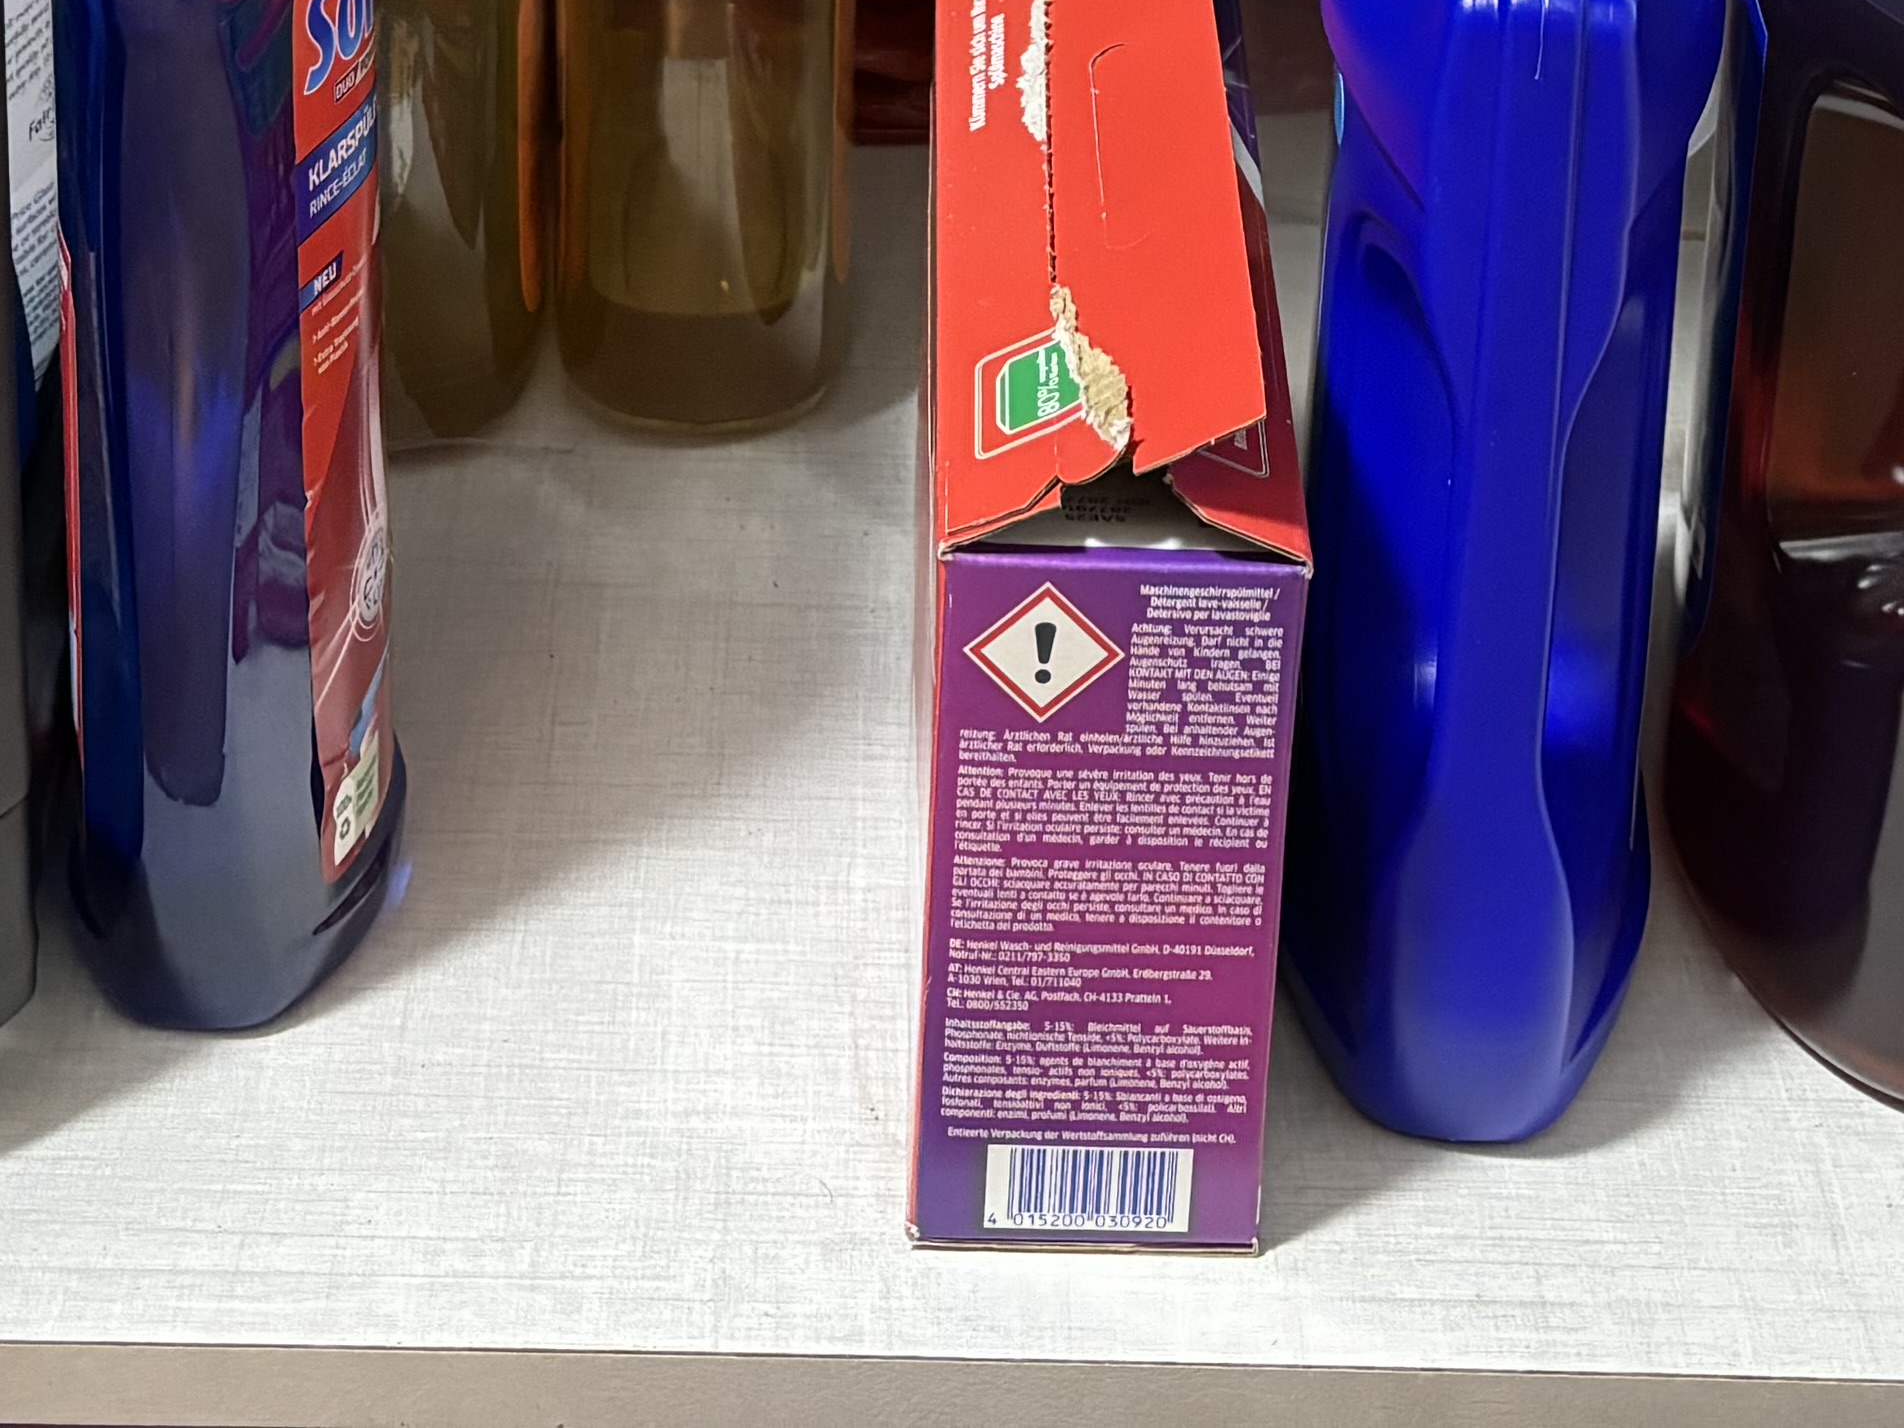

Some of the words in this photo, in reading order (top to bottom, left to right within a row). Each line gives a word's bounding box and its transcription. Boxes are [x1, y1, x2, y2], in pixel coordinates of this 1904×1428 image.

[336, 72, 356, 100] DUO
[313, 261, 337, 297] NEU
[1037, 376, 1060, 417] 80%
[1139, 584, 1274, 600] Maschinengeschirrspülmittel
[1146, 608, 1192, 620] Detersivo
[1193, 610, 1211, 621] per
[1184, 624, 1234, 636] Verursacht
[1201, 635, 1222, 646] Darf
[1226, 637, 1249, 647] nicht
[1268, 638, 1284, 648] die
[1128, 667, 1174, 679] KONTAKT
[1174, 668, 1192, 679] MIT
[1193, 669, 1213, 680] DEN
[966, 939, 998, 951] Henkel
[1034, 941, 1052, 952] und
[1053, 941, 1130, 955] Reinigungsmittel
[964, 963, 996, 975] Henkel
[997, 965, 1030, 976] Central
[1031, 966, 1066, 977] Eastern
[1067, 967, 1100, 979] Europe
[963, 988, 996, 999] Henkel
[990, 1128, 1043, 1141] Verpackung
[1044, 1130, 1059, 1140] der
[1061, 1130, 1148, 1143] Wertstoffsammlung
[987, 1212, 997, 1225] 4
[1013, 1213, 1086, 1227] 015200
[1095, 1214, 1167, 1229] 030920
